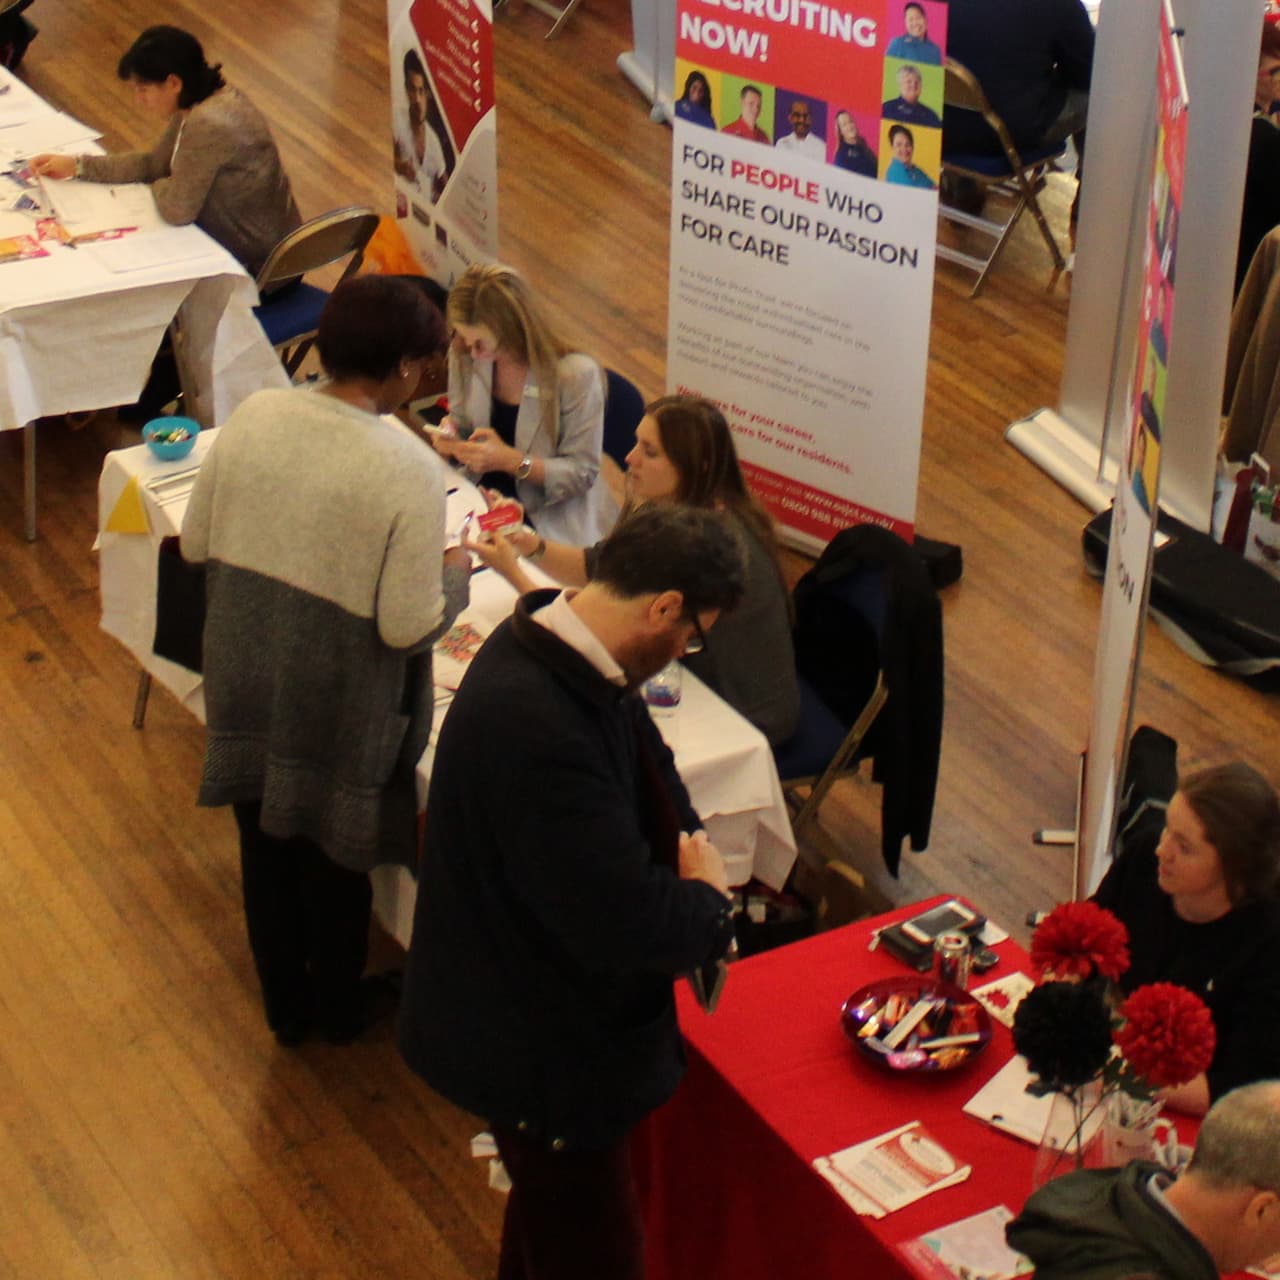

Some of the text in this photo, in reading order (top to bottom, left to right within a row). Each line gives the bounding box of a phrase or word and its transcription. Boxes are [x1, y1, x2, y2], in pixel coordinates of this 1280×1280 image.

[680, 12, 769, 63] NOW!
[683, 144, 883, 224] FOR PEOPLE WHO
[681, 214, 790, 266] FOR CARE
[682, 178, 919, 269] SHARE OUR PASSION
[730, 403, 749, 417] for
[749, 408, 775, 426] your
[756, 430, 773, 444] for
[774, 438, 795, 452] our
